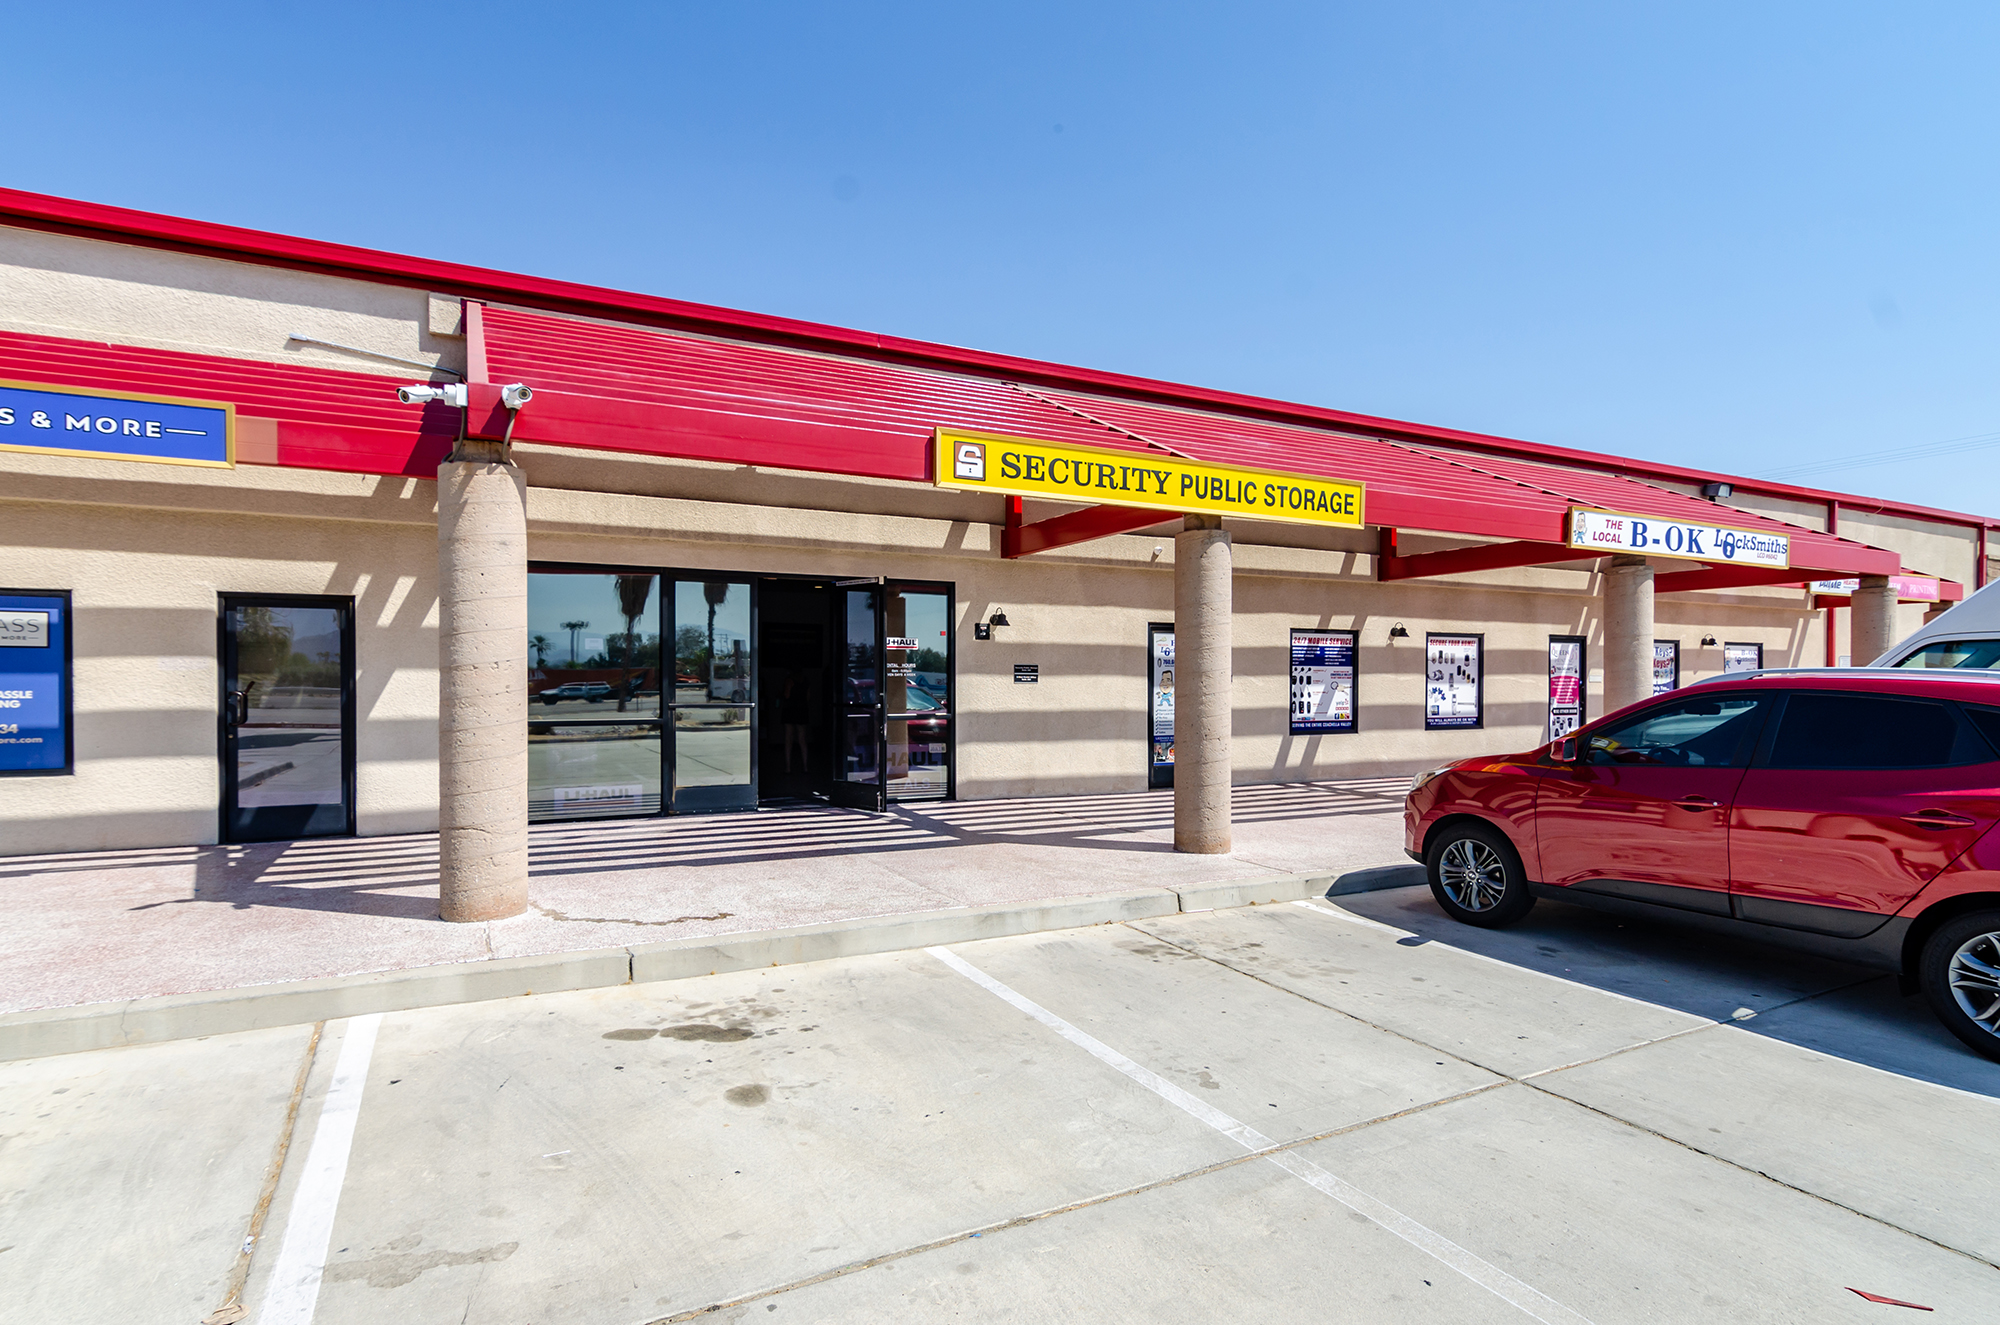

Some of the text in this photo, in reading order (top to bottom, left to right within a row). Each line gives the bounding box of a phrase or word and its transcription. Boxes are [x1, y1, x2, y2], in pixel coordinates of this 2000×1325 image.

[0, 408, 162, 438] S & MORE
[1001, 452, 1355, 516] SECURITY PUBLIC STORAGE
[1606, 519, 1623, 530] THE
[1593, 531, 1622, 544] LOCAL
[1630, 521, 1705, 554] B-OK
[1909, 584, 1936, 595] PRINTING
[1293, 636, 1352, 646] 24/7 MOBILE SERVICE
